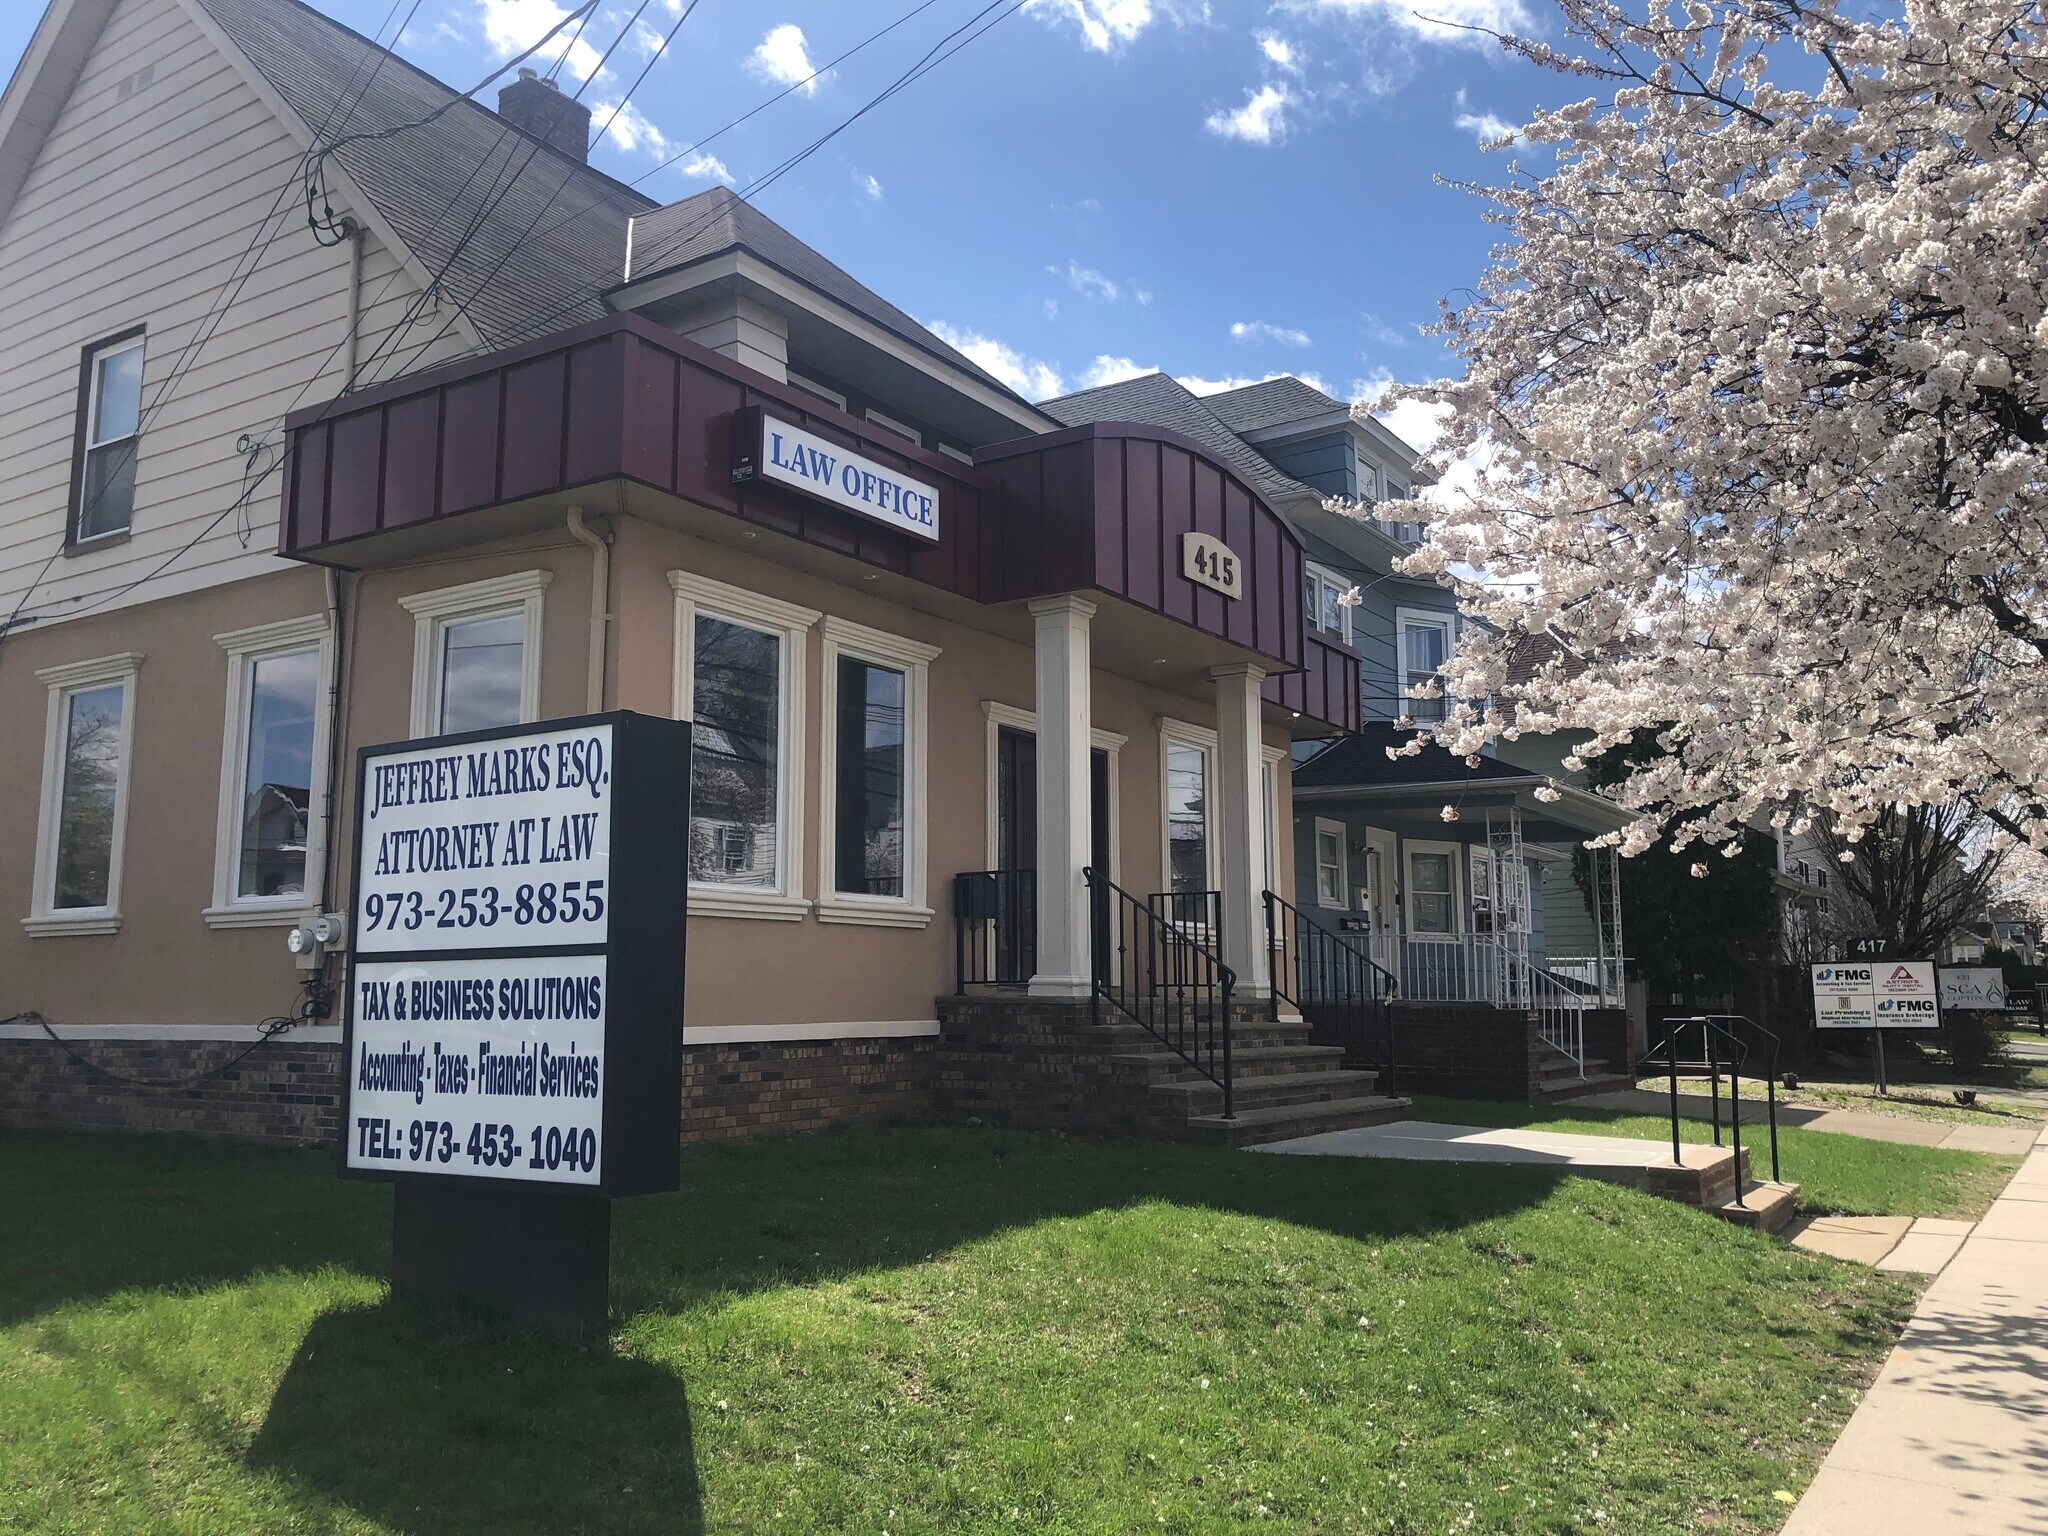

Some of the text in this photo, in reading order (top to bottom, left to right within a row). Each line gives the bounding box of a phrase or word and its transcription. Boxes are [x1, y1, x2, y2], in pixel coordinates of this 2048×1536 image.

[770, 432, 934, 528] LAW OFFICE
[1195, 544, 1234, 587] 415
[371, 737, 609, 820] JEFFREY MARKS ESQ.
[374, 812, 598, 875] ATTORNEY AT LAW
[365, 879, 604, 932] 973-253-8855
[1857, 940, 1887, 953] 417
[361, 976, 601, 1021] TAX & BUSINESS SOLUTIONS
[1835, 970, 1870, 980] FMG
[1947, 984, 1982, 994] SCA
[1897, 1001, 1934, 1011] FMG
[359, 1041, 425, 1105] Accounting
[434, 1041, 468, 1095] Taxes
[478, 1039, 537, 1098] Financial
[541, 1040, 599, 1099] Services
[357, 1118, 403, 1159] TEL:
[529, 1126, 596, 1173] 1040
